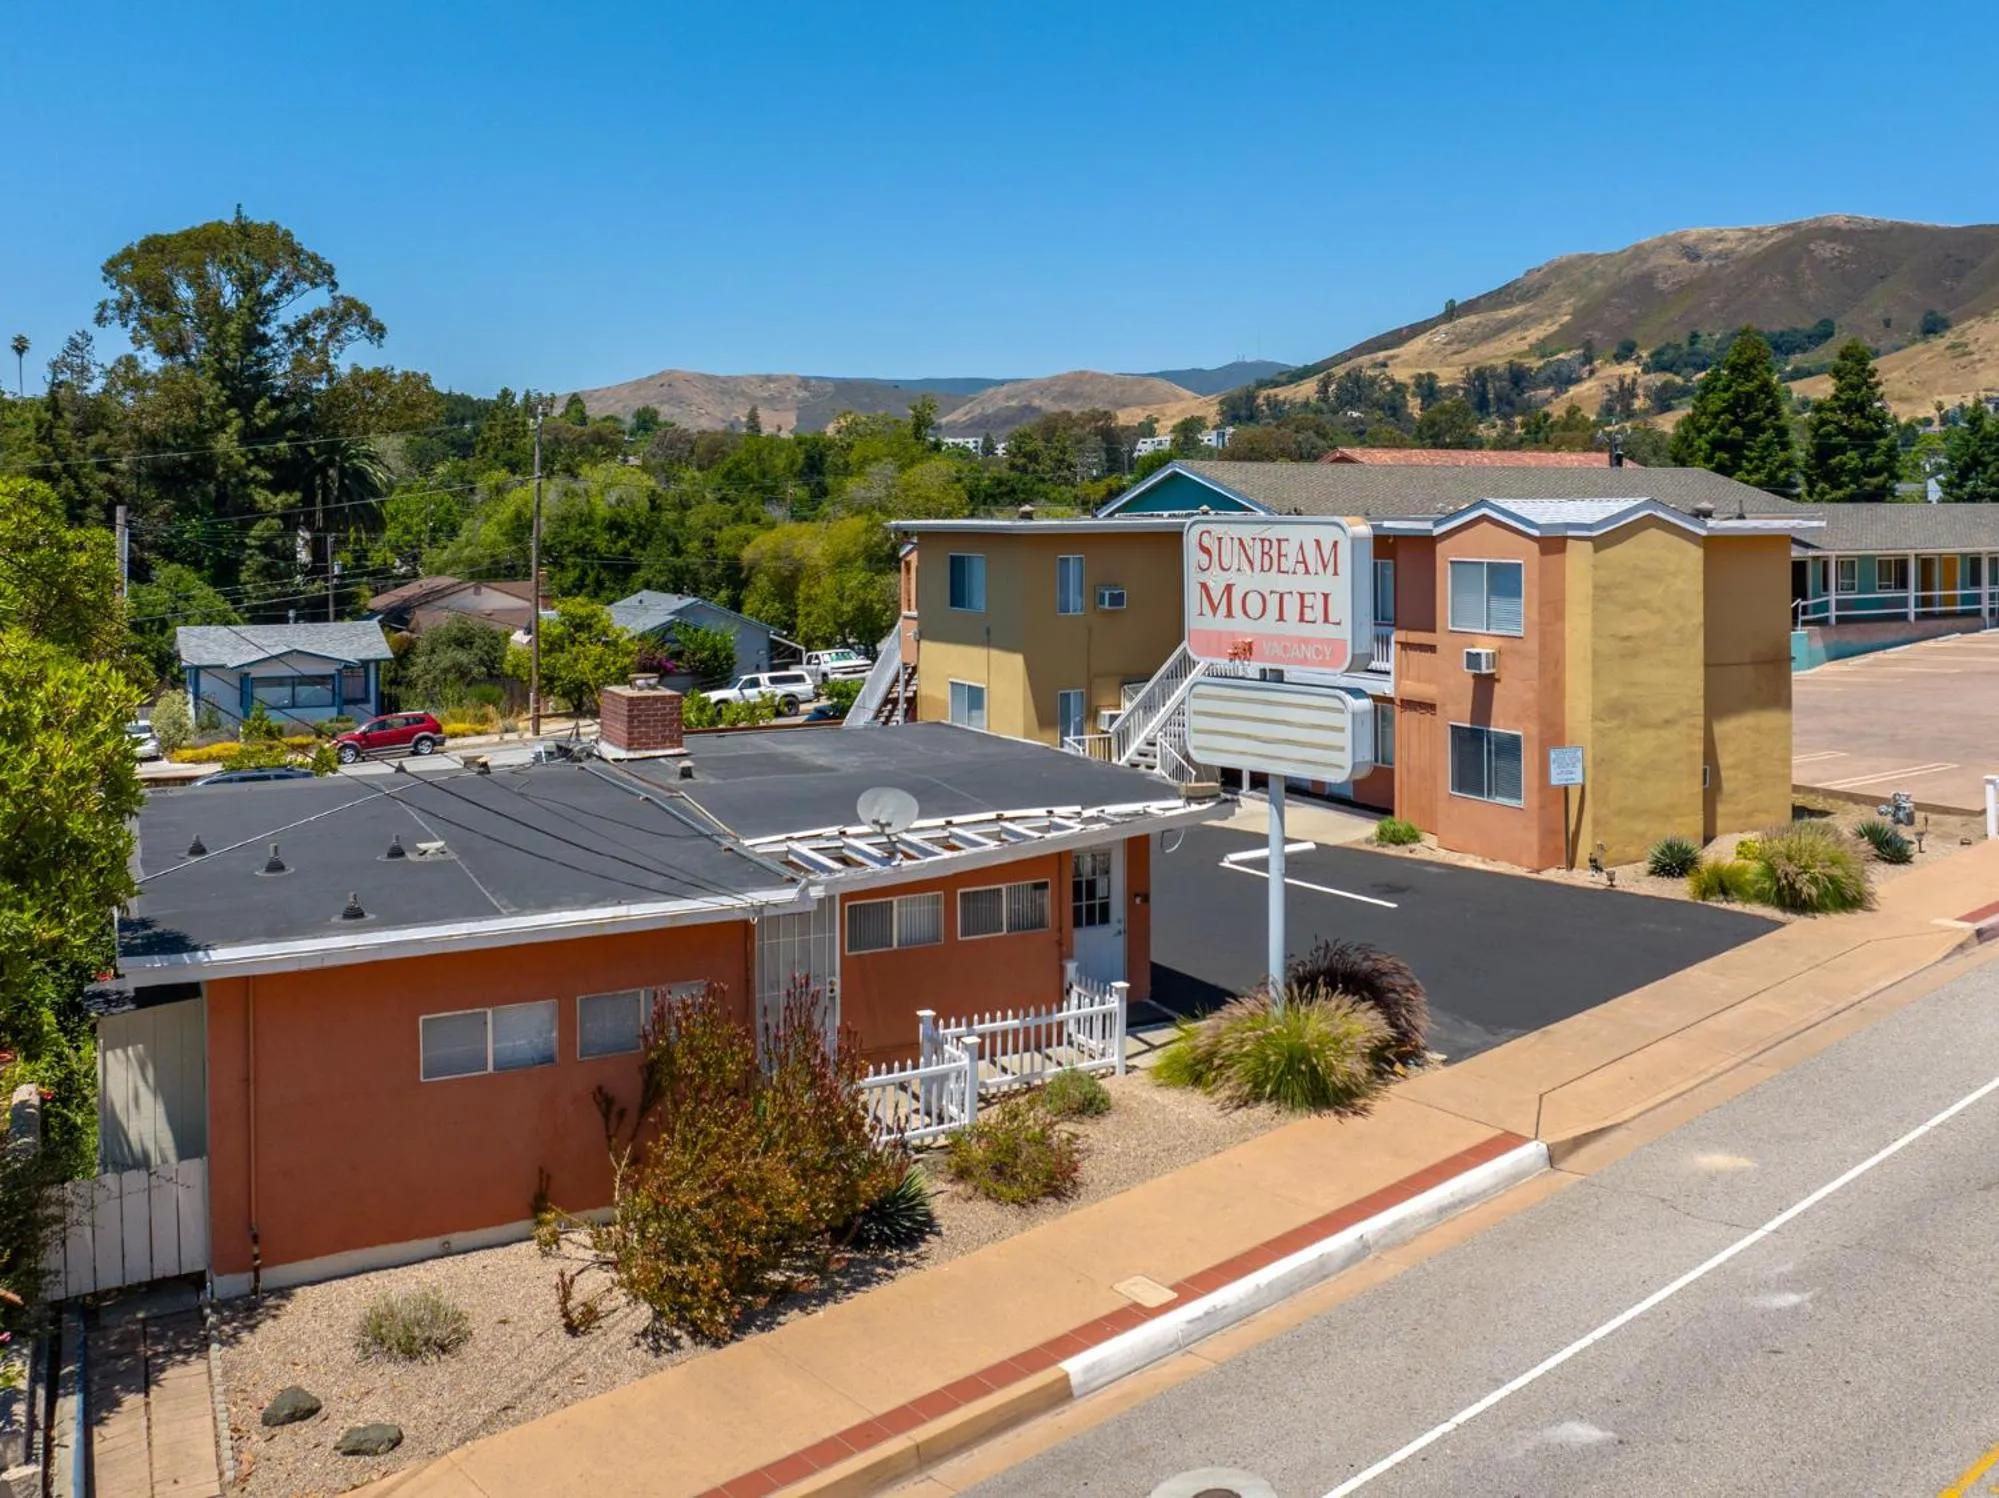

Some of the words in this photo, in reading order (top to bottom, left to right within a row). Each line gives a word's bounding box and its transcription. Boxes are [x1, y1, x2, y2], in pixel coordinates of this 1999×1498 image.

[1197, 530, 1340, 576] SUNBEAM
[1197, 581, 1342, 625] MOTEL
[1262, 640, 1333, 660] VACANCY
